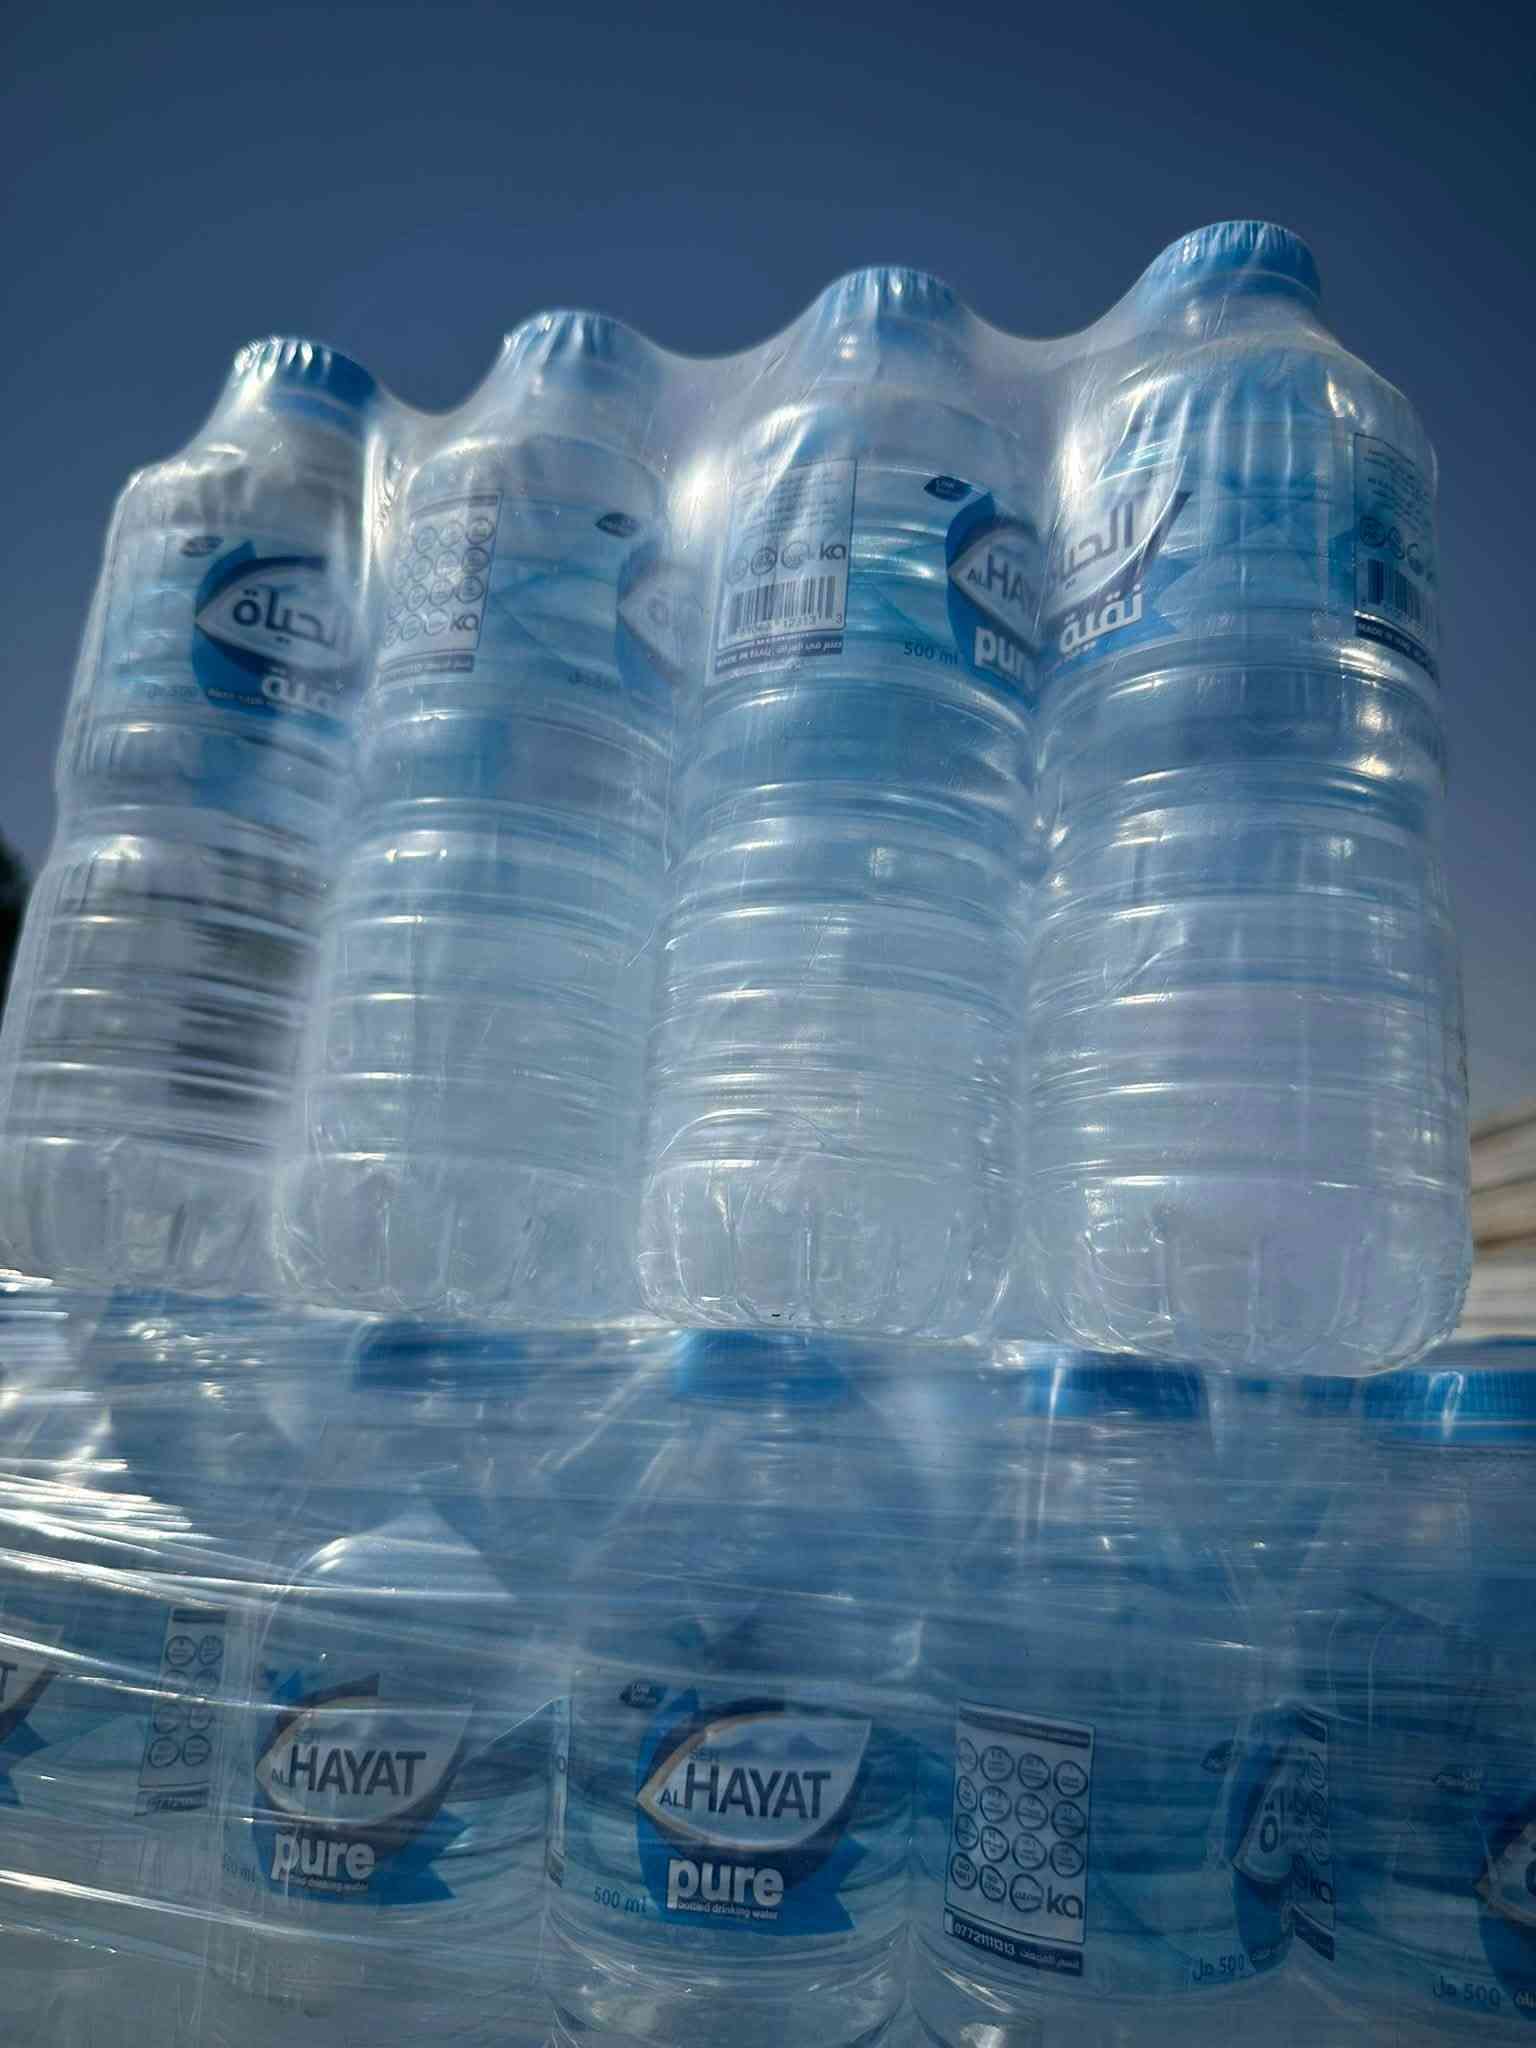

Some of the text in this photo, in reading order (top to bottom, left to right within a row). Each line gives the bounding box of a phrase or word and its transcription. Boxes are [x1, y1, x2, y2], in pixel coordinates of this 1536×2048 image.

[820, 543, 847, 561] ka
[1061, 499, 1135, 593] الحي
[1059, 583, 1143, 656] نقية
[904, 640, 934, 660] 500
[288, 1743, 427, 1798] HAYAT
[660, 1763, 831, 1820] AL HAYAT
[271, 1831, 378, 1882] pure
[593, 1886, 621, 1910] 500
[666, 1858, 784, 1909] pure
[1046, 1884, 1083, 1919] ka
[1218, 1951, 1245, 1977] 500
[1464, 1982, 1501, 2009] 500
